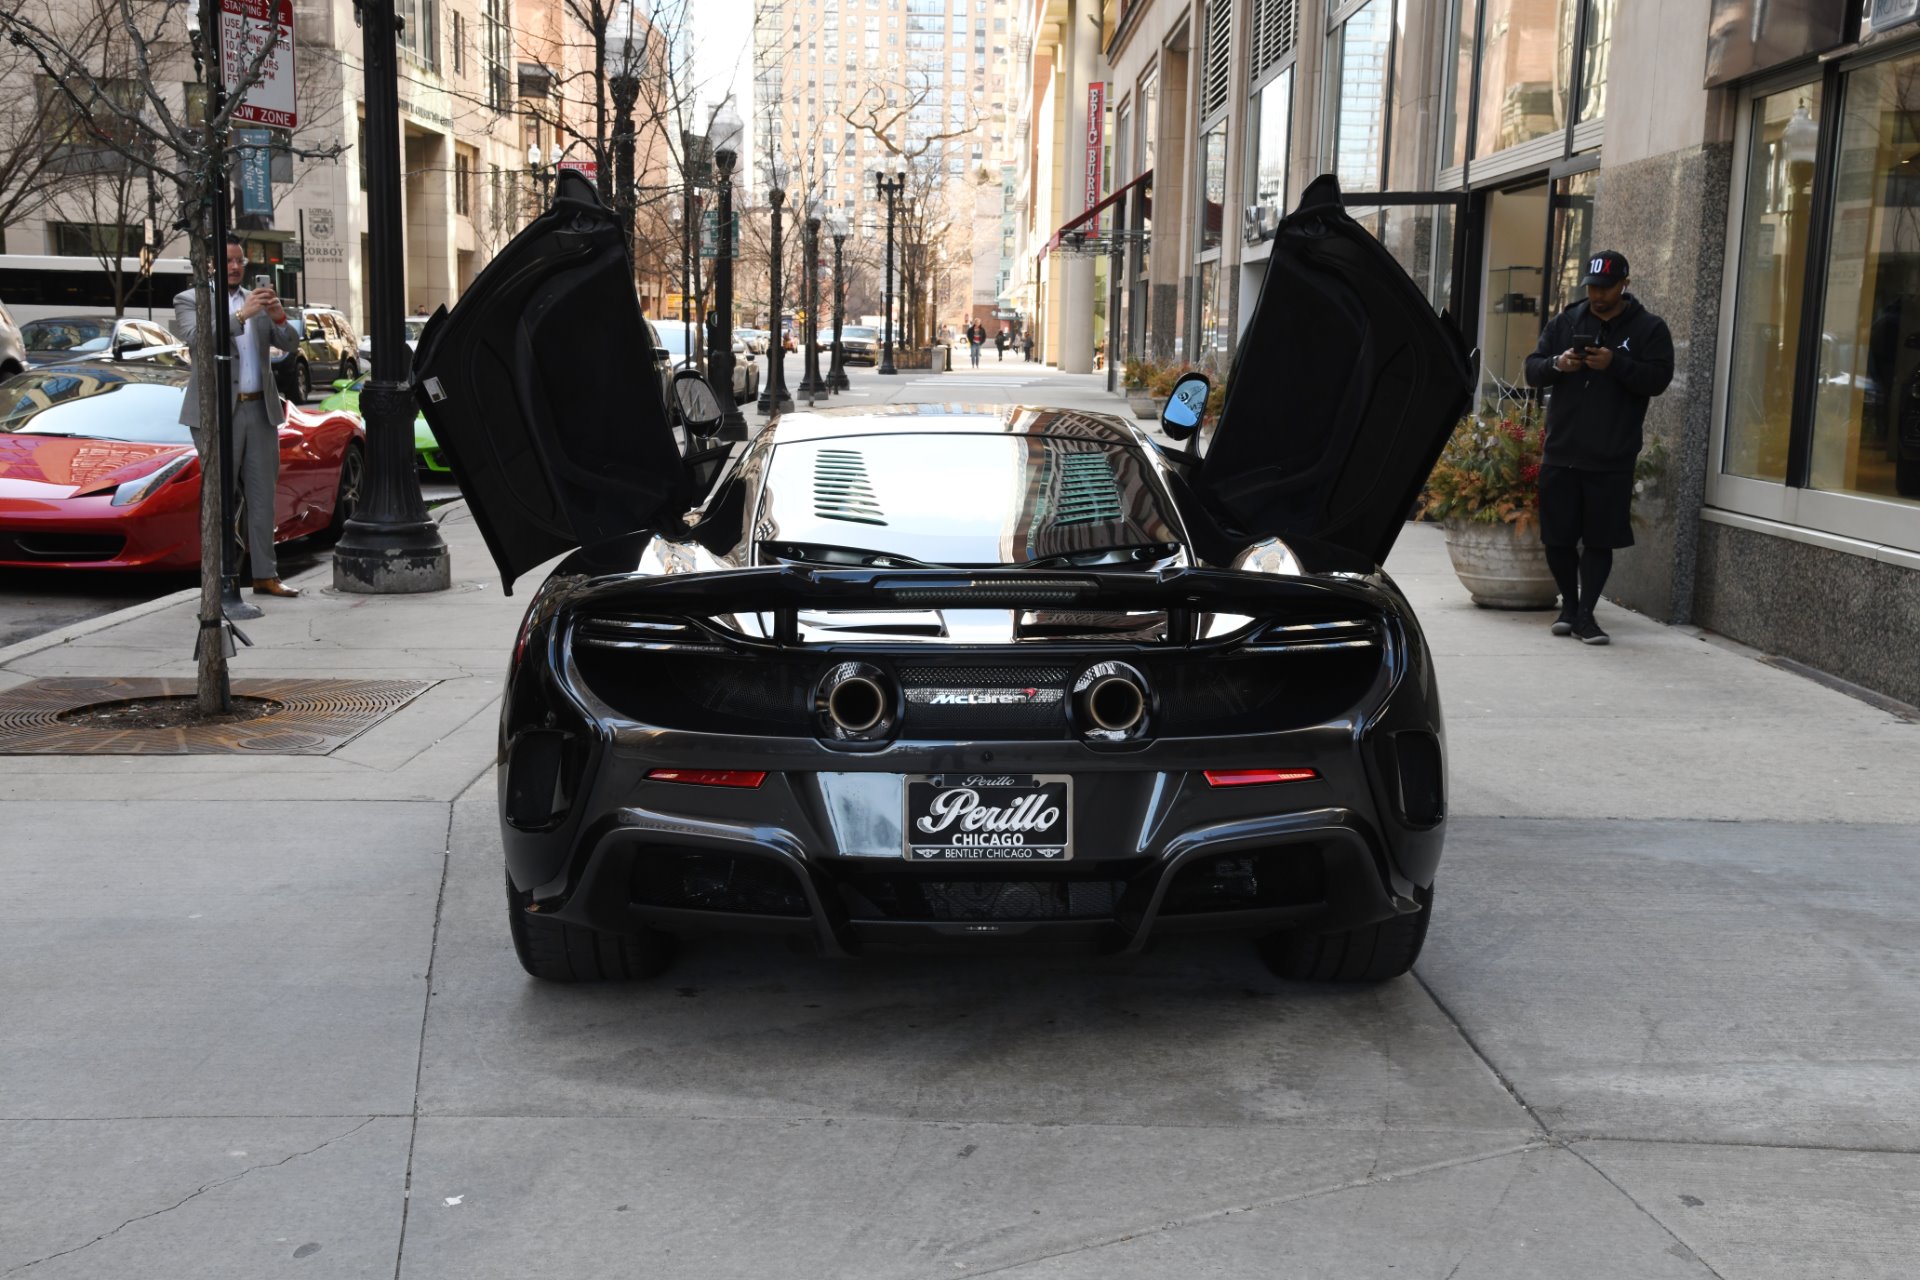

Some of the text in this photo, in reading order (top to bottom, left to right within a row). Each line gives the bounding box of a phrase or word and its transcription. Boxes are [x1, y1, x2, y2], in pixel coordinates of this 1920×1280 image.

[225, 17, 240, 29] USE
[226, 40, 235, 50] 10
[227, 63, 235, 73] 10
[263, 70, 275, 80] PM
[260, 109, 291, 126] ZONE
[1088, 88, 1098, 144] EPIC
[1590, 258, 1612, 274] 10X
[930, 693, 1027, 705] McLaren
[961, 775, 1016, 787] Perillo
[916, 788, 1060, 834] Perillo
[952, 833, 1024, 846] CHICAGO
[945, 848, 1033, 859] BENTLEY CHICAGO
